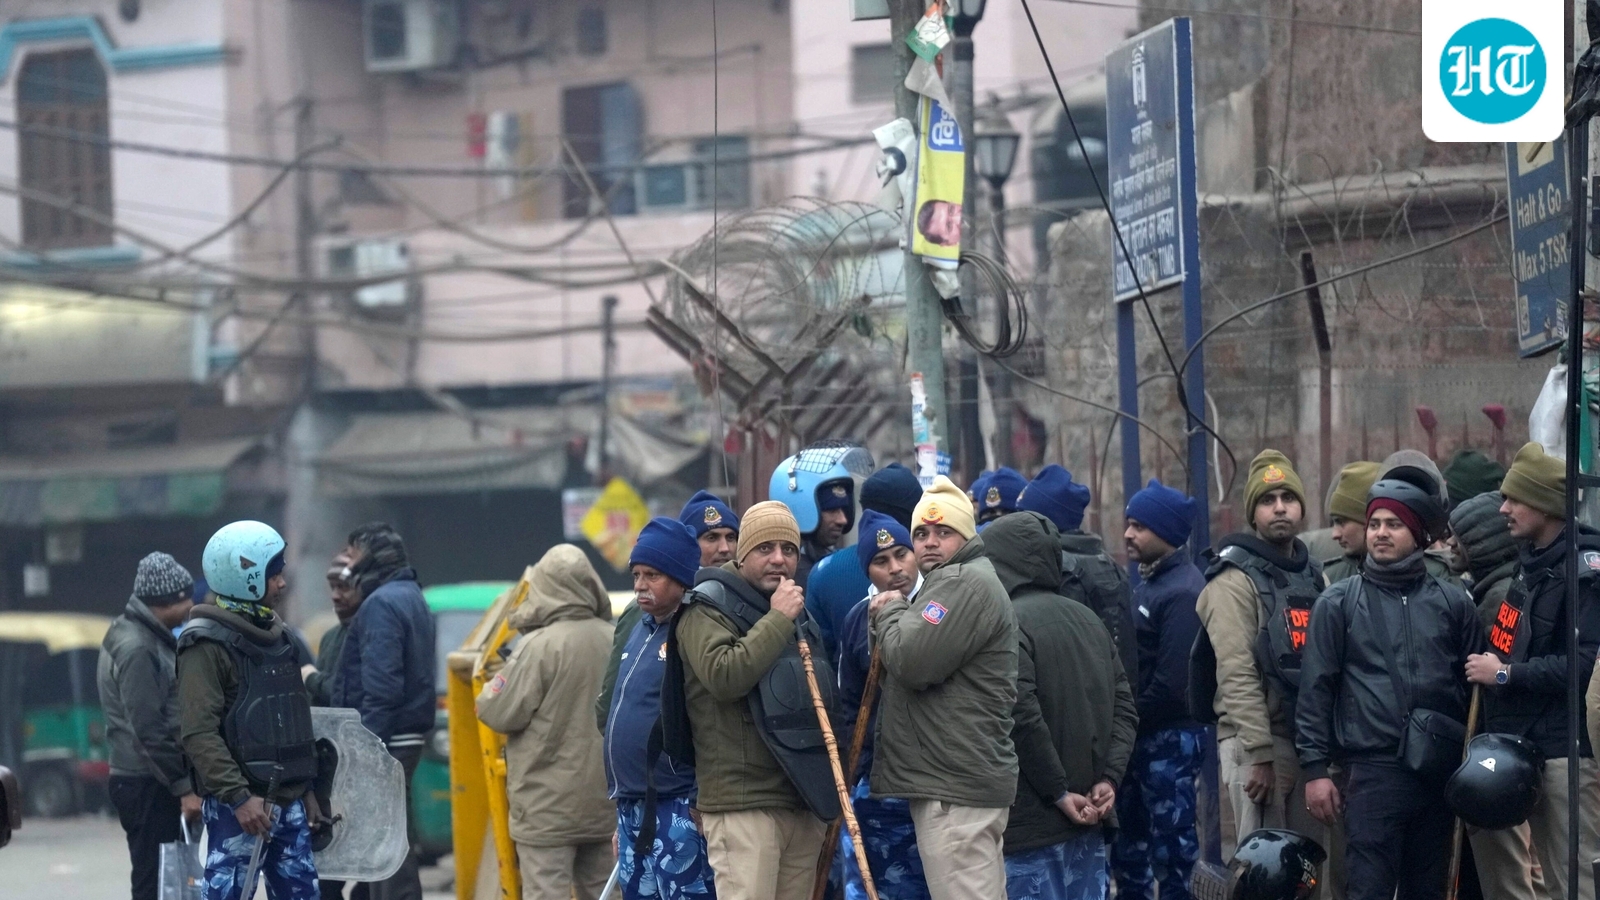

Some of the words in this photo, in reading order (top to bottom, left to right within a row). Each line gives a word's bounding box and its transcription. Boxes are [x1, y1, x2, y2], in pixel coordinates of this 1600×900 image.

[1516, 192, 1537, 230] Halt
[1538, 187, 1546, 220] &
[1547, 182, 1561, 215] Go
[1518, 249, 1538, 282] Max
[1539, 241, 1546, 274] 5
[1546, 232, 1568, 270] TSR
[1497, 602, 1519, 629] DELHI
[1490, 624, 1513, 653] POLICE
